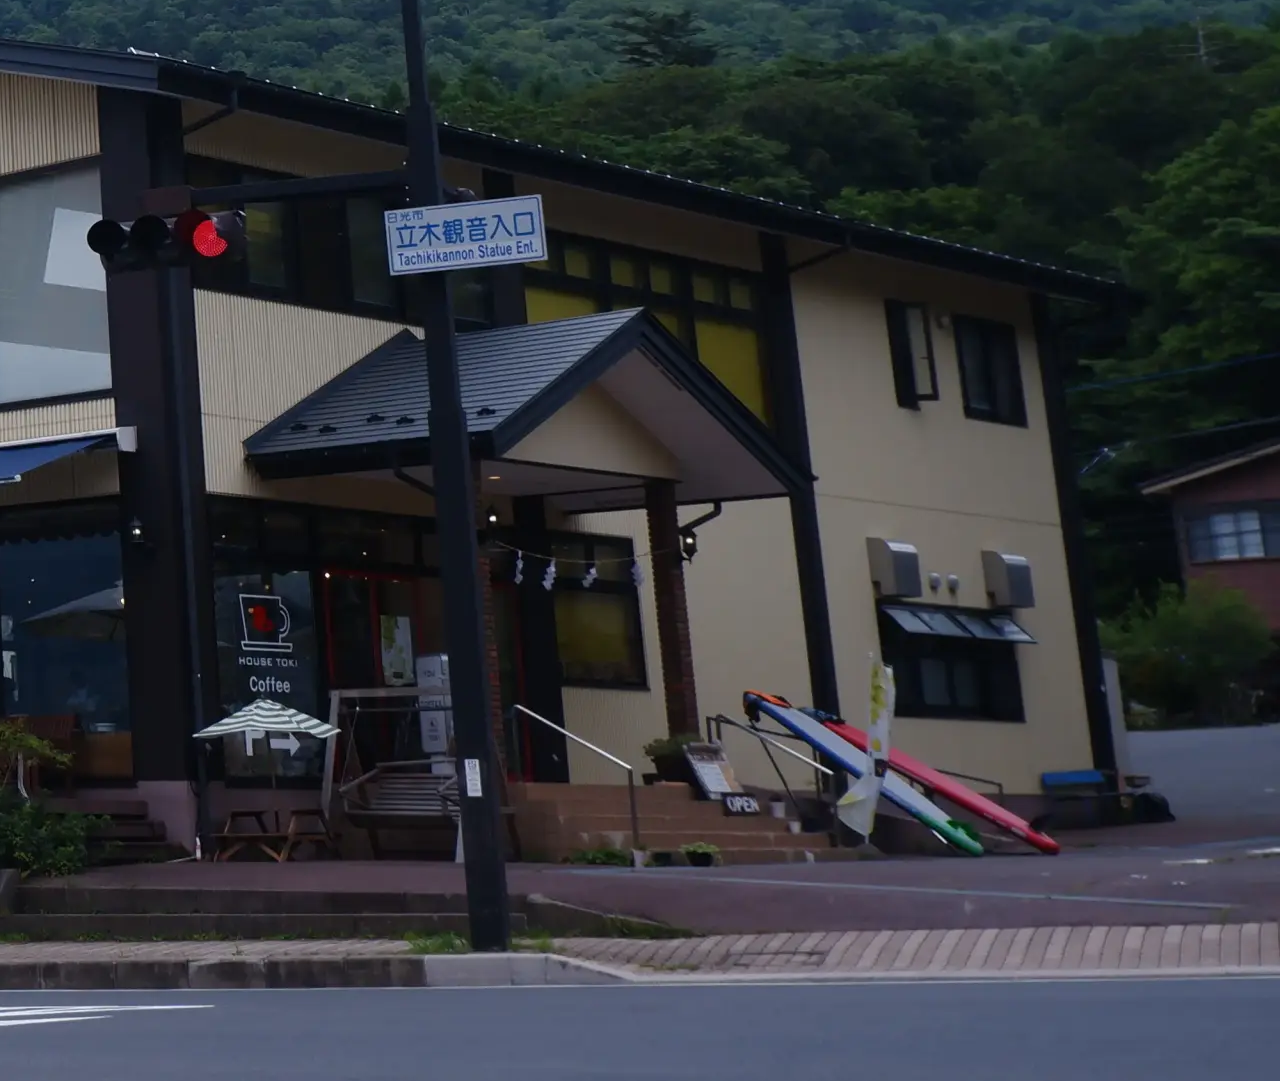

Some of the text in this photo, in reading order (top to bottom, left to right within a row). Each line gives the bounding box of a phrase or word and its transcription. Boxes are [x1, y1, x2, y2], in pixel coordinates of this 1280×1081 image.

[387, 210, 424, 224] 日光市
[396, 212, 535, 249] 立木観音入口
[397, 239, 538, 267] Tachikikannon Statue Ent.
[239, 656, 298, 667] HOUSE TOKI
[249, 675, 291, 693] Coffee
[726, 796, 760, 812] OPEN
